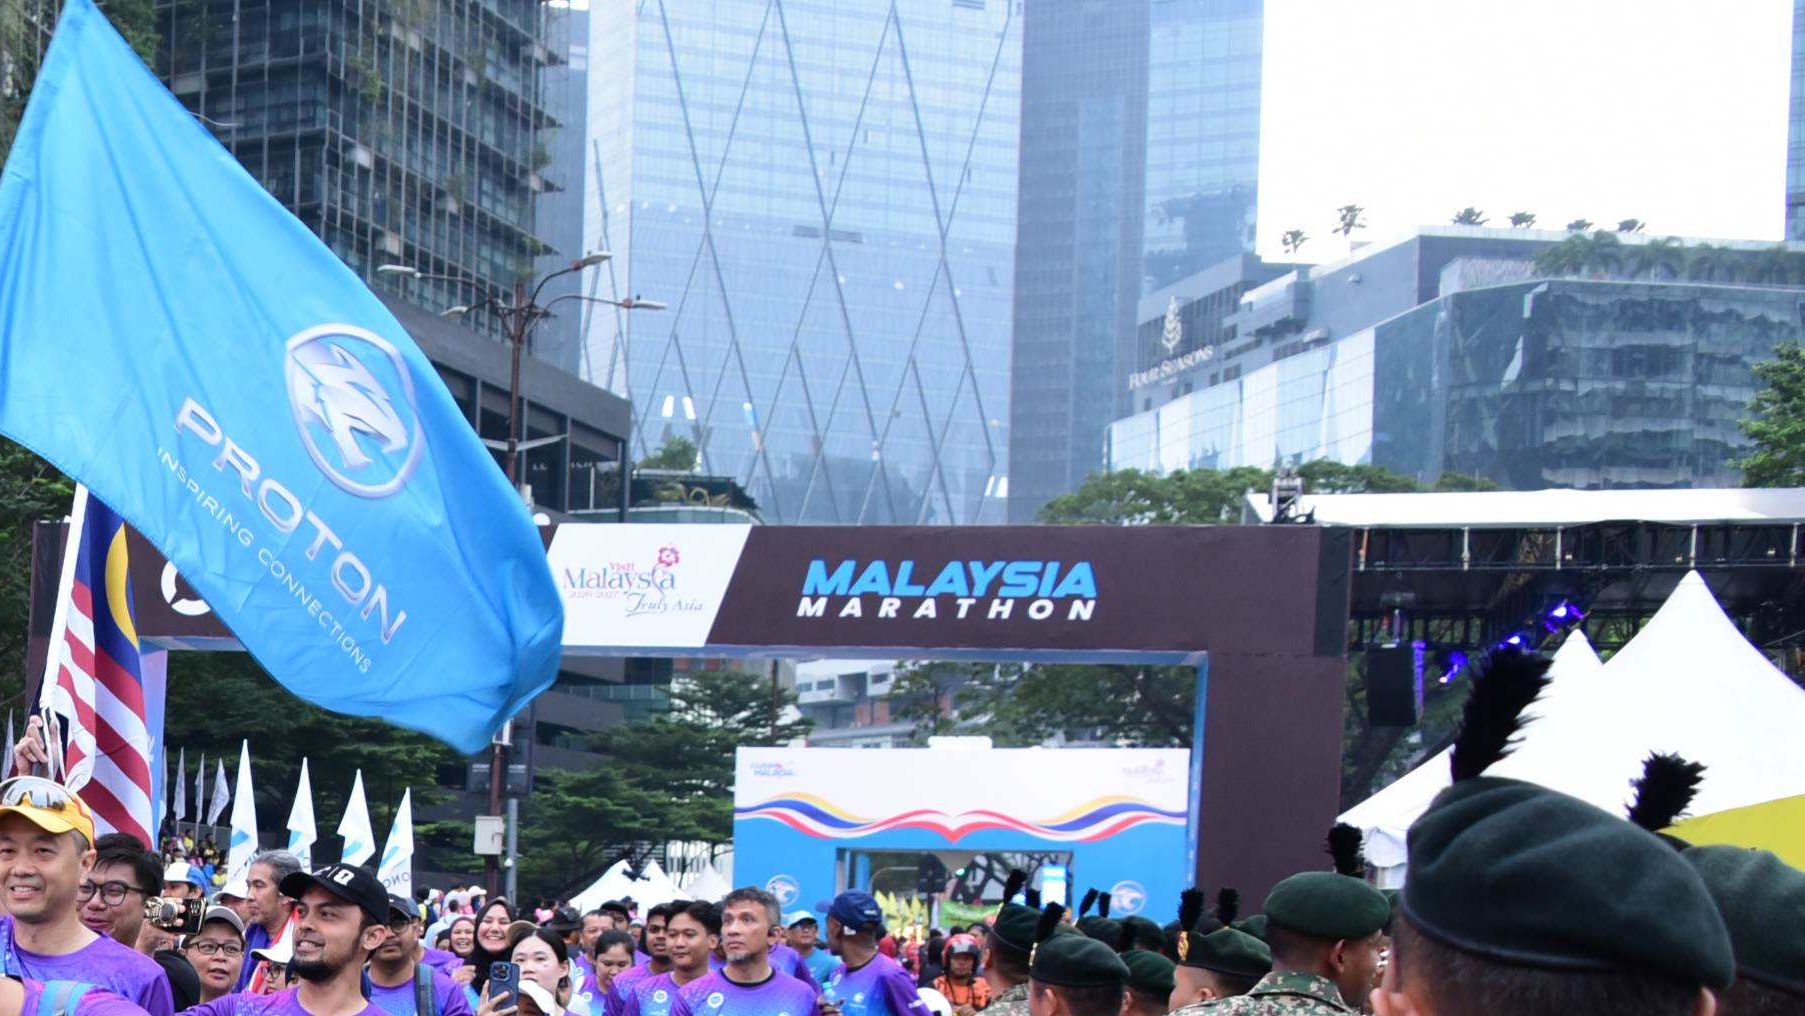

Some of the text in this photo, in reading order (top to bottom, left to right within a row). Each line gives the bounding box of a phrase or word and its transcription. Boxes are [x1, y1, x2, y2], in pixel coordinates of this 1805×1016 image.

[173, 397, 408, 645] PROTON
[157, 447, 372, 674] INSPIRING CONNECTIONS
[563, 566, 677, 592] Malaysia
[802, 560, 1098, 598] MALAYSIA
[625, 592, 669, 614] Truly
[796, 597, 1096, 620] MARATHON
